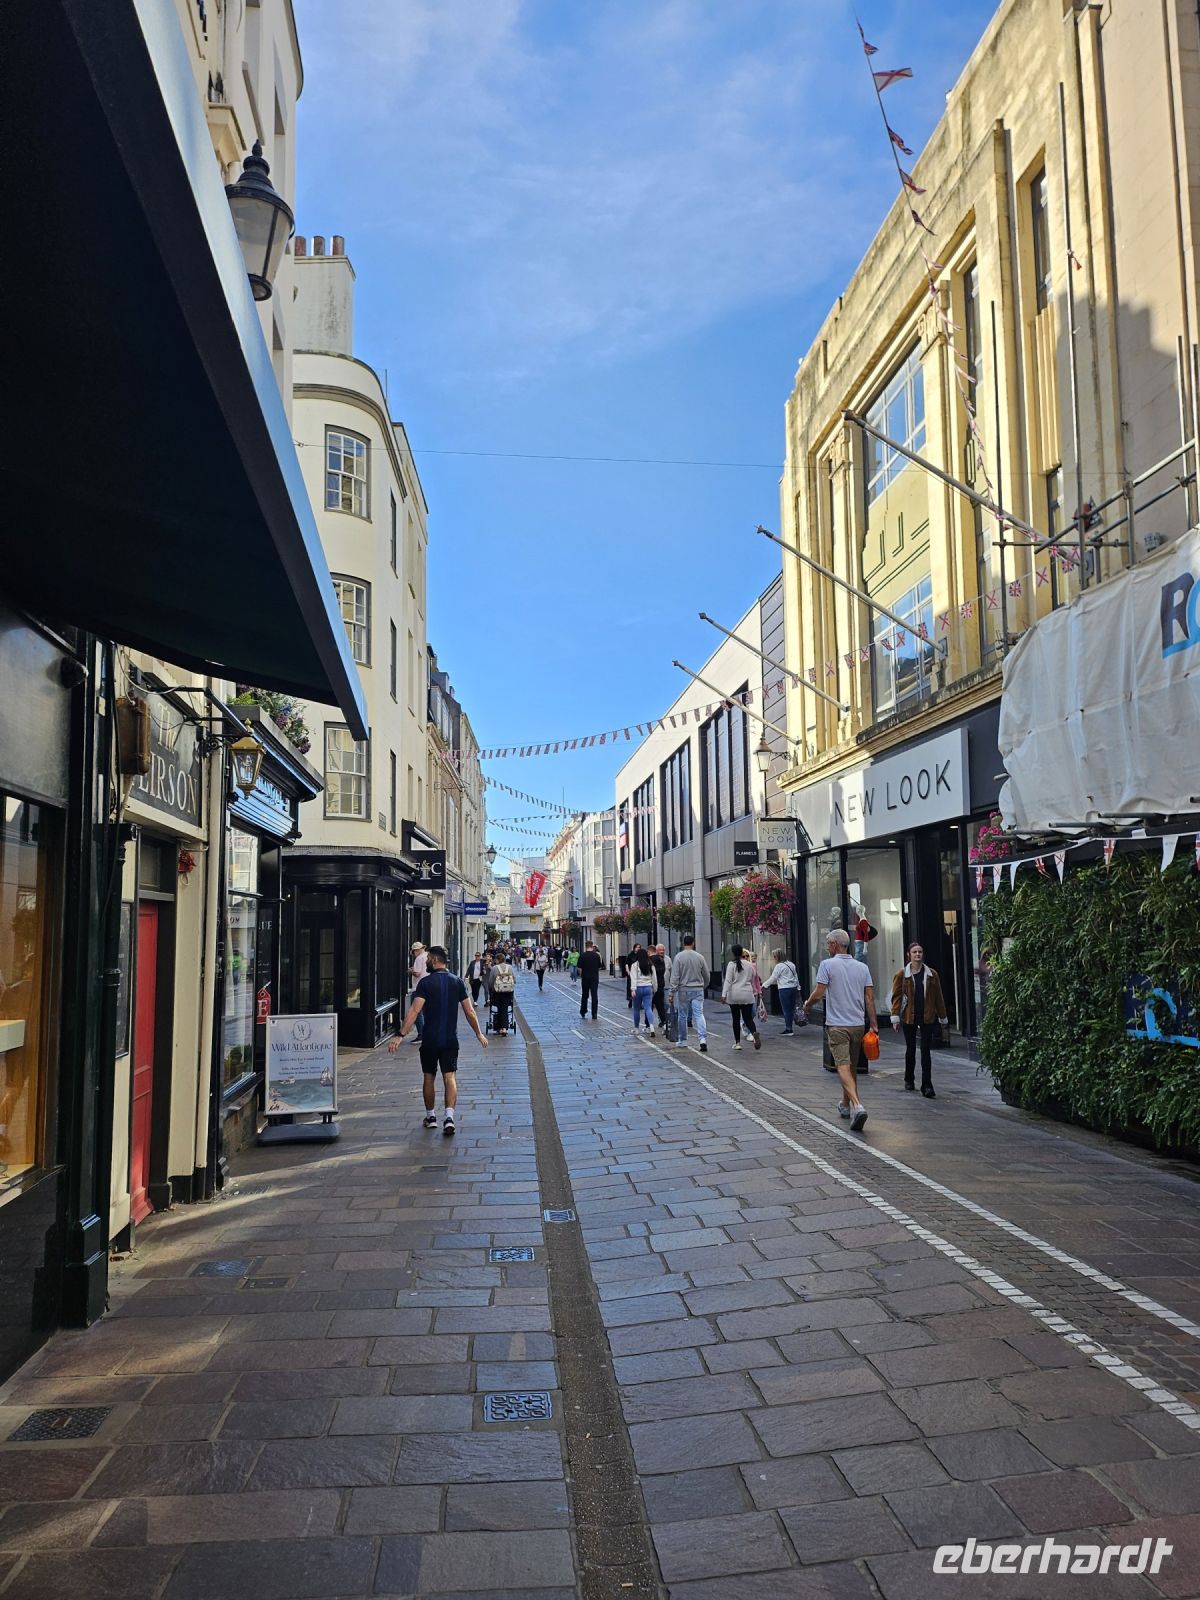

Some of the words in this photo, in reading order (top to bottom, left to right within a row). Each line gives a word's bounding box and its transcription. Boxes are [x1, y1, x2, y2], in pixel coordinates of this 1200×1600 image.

[157, 702, 177, 755] The
[132, 751, 198, 816] IRSON
[834, 788, 875, 826] NEW
[886, 759, 952, 811] LOOK
[762, 827, 791, 835] NEW
[271, 1042, 290, 1052] Wild
[292, 1041, 332, 1053] Atlantique
